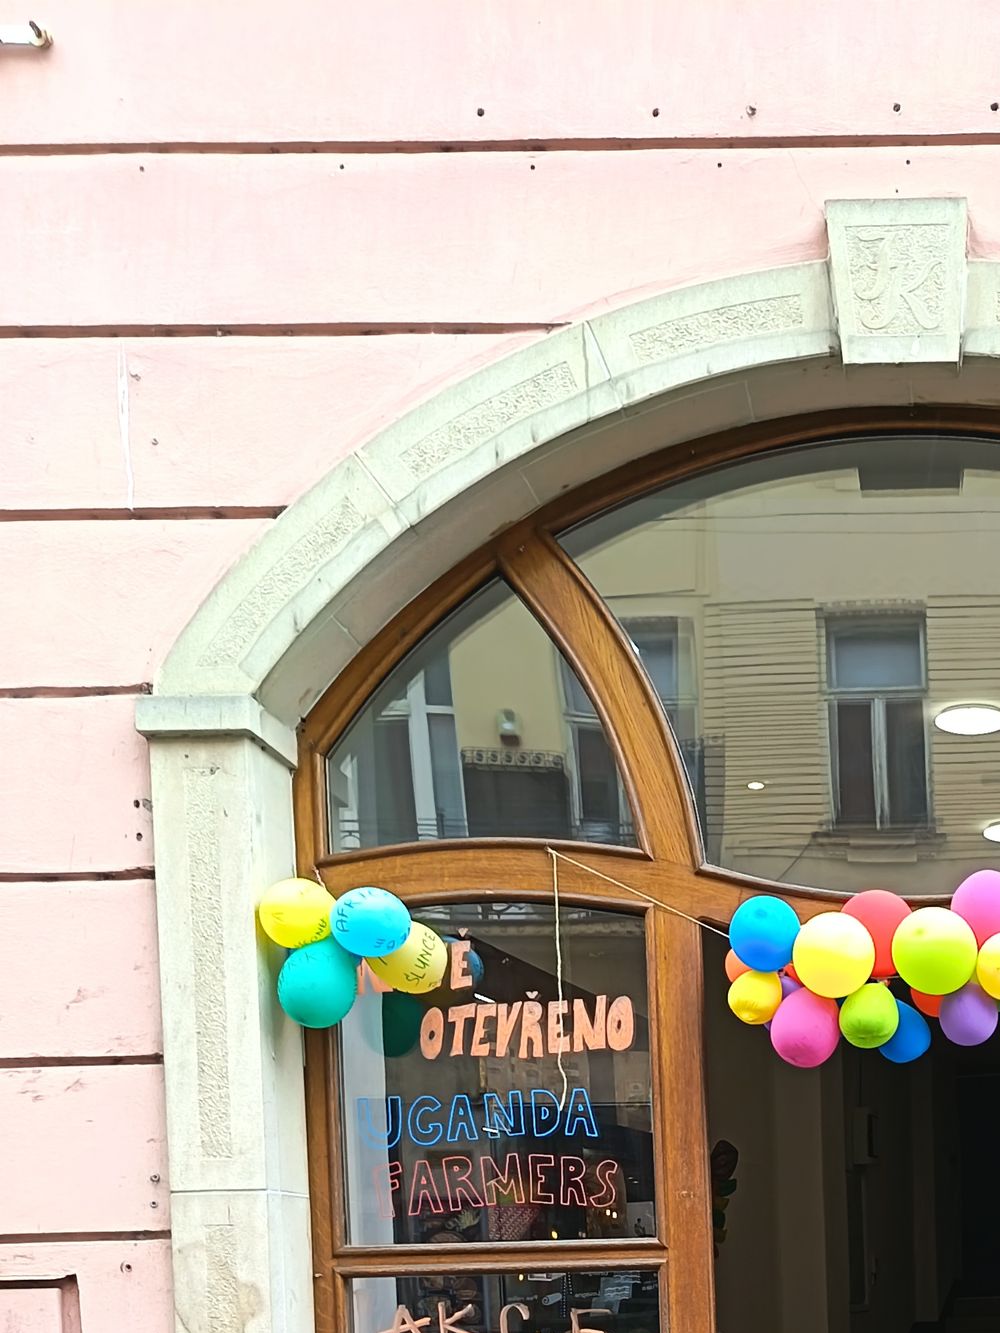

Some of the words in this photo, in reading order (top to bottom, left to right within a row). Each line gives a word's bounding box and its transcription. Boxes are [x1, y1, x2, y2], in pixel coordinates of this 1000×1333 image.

[420, 990, 635, 1060] OTEVŘENO
[357, 1088, 598, 1149] UGANDA
[373, 1153, 618, 1218] FARMERS
